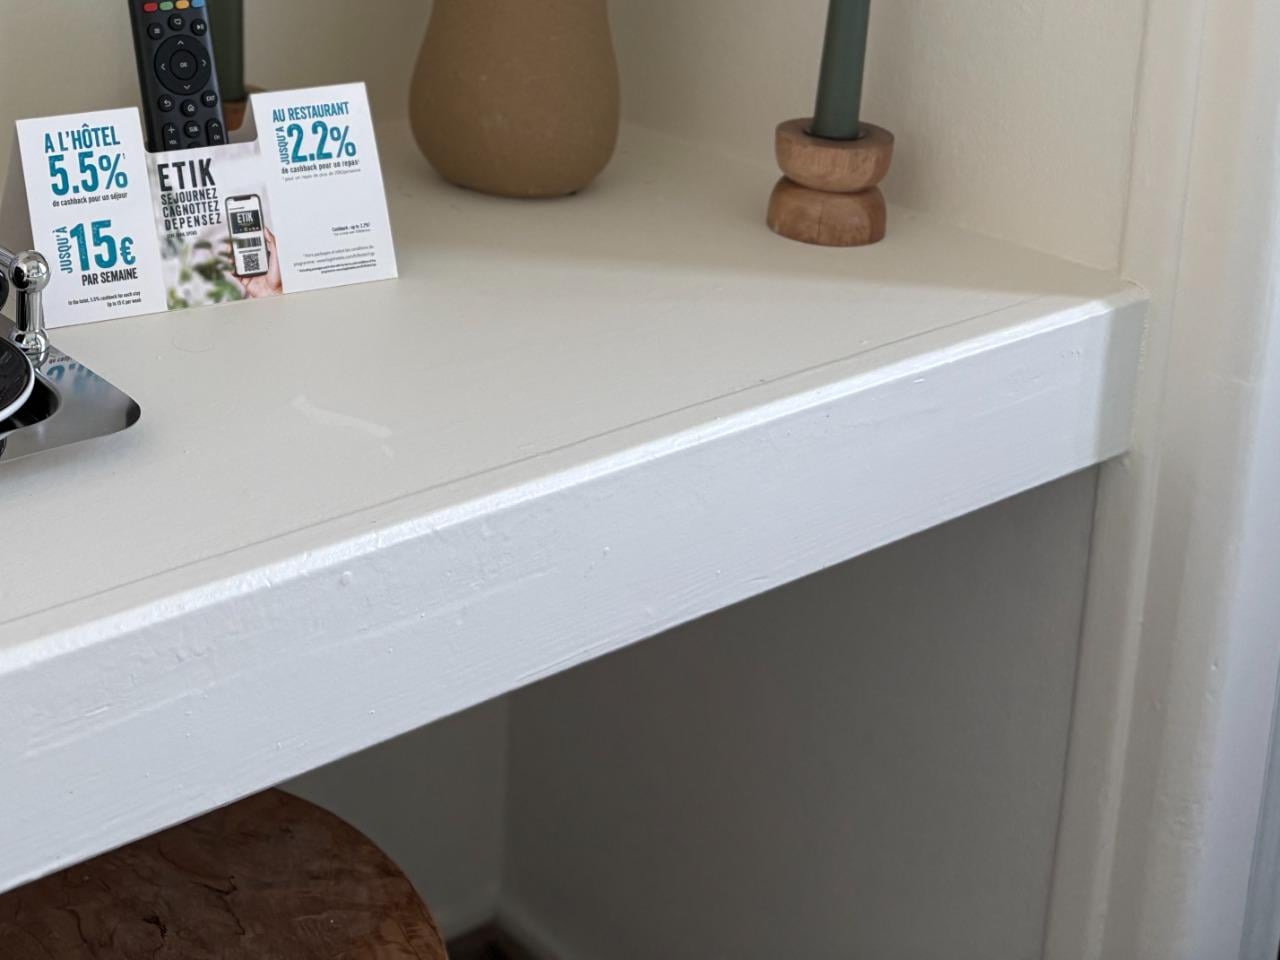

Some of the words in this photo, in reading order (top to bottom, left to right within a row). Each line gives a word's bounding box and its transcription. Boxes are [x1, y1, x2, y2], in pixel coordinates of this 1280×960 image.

[272, 109, 285, 123] AU
[287, 101, 349, 121] RESTAURANT
[45, 133, 55, 153] A
[57, 123, 121, 151] L'HÔTEL
[286, 120, 357, 163] 2.2%
[157, 158, 216, 192] ETIK
[290, 163, 317, 173] cashback
[61, 195, 87, 206] cashback
[160, 187, 218, 205] SEJOURNEZ
[162, 200, 220, 218] CAGNOTTEZ
[236, 212, 254, 224] ETIK
[164, 212, 222, 231] DEPENSEZ
[81, 273, 99, 286] PAR
[100, 268, 138, 284] SEMAINE
